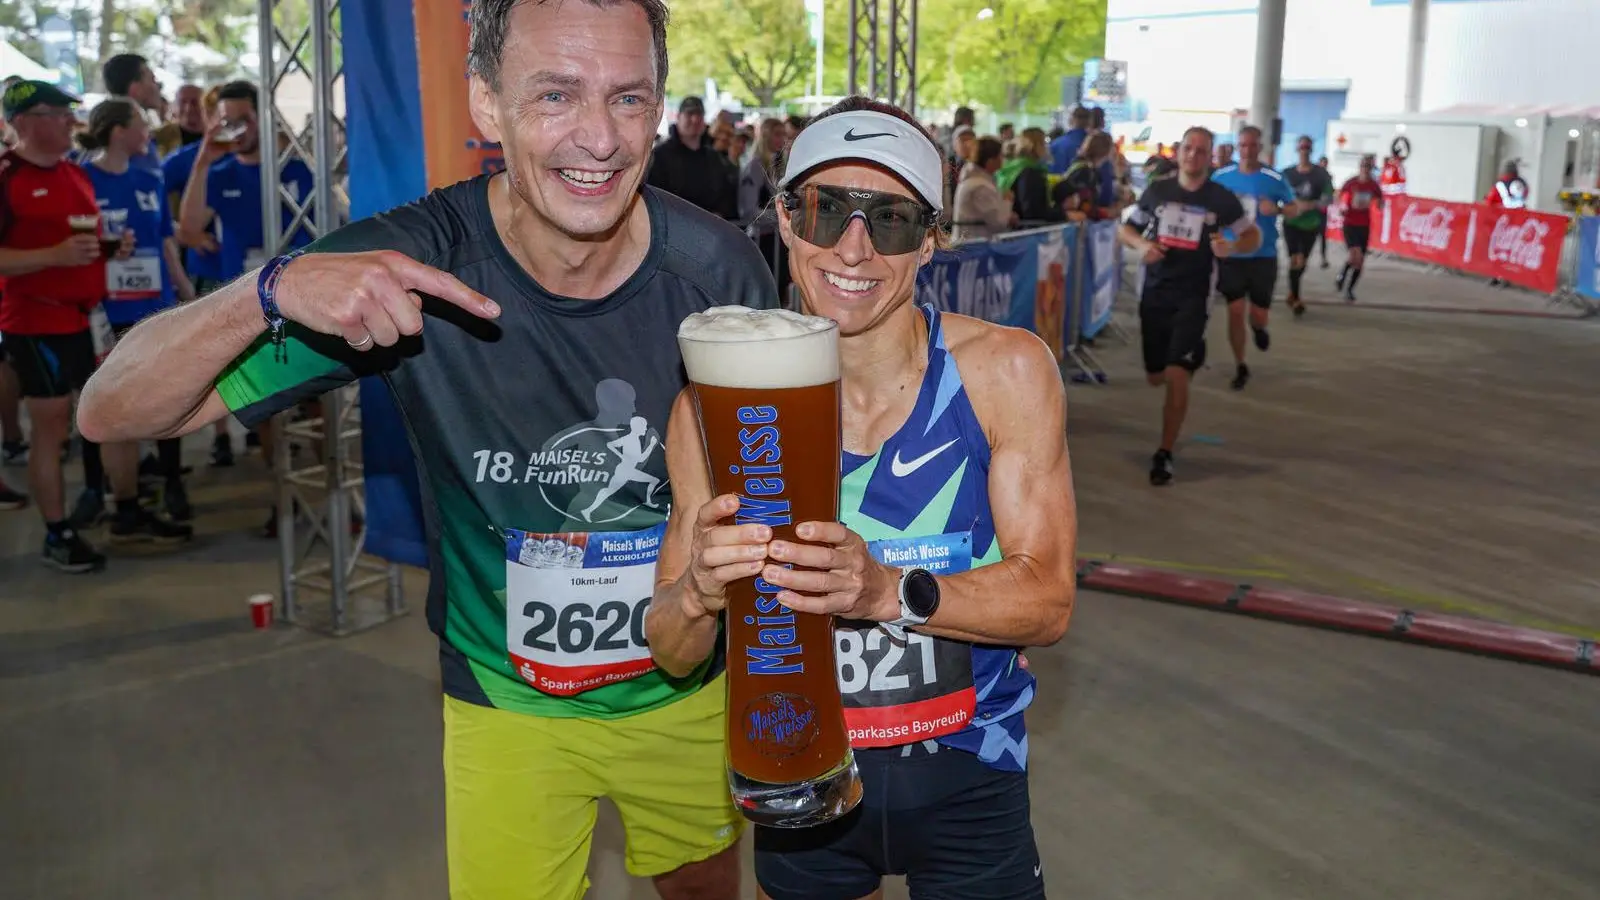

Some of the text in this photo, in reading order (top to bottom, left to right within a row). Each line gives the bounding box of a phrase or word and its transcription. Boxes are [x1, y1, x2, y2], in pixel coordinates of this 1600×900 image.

[473, 449, 519, 484] 18.
[528, 450, 607, 465] MAISEL'S
[729, 405, 791, 526] Weisse
[523, 464, 610, 485] FunRun
[602, 537, 659, 553] Maisel's Weisse
[883, 544, 949, 563] Maisel's Weisse
[571, 576, 618, 586] 10km-Lauf
[540, 676, 602, 690] Sparkasse
[848, 709, 967, 741] parkasse Bayreuth
